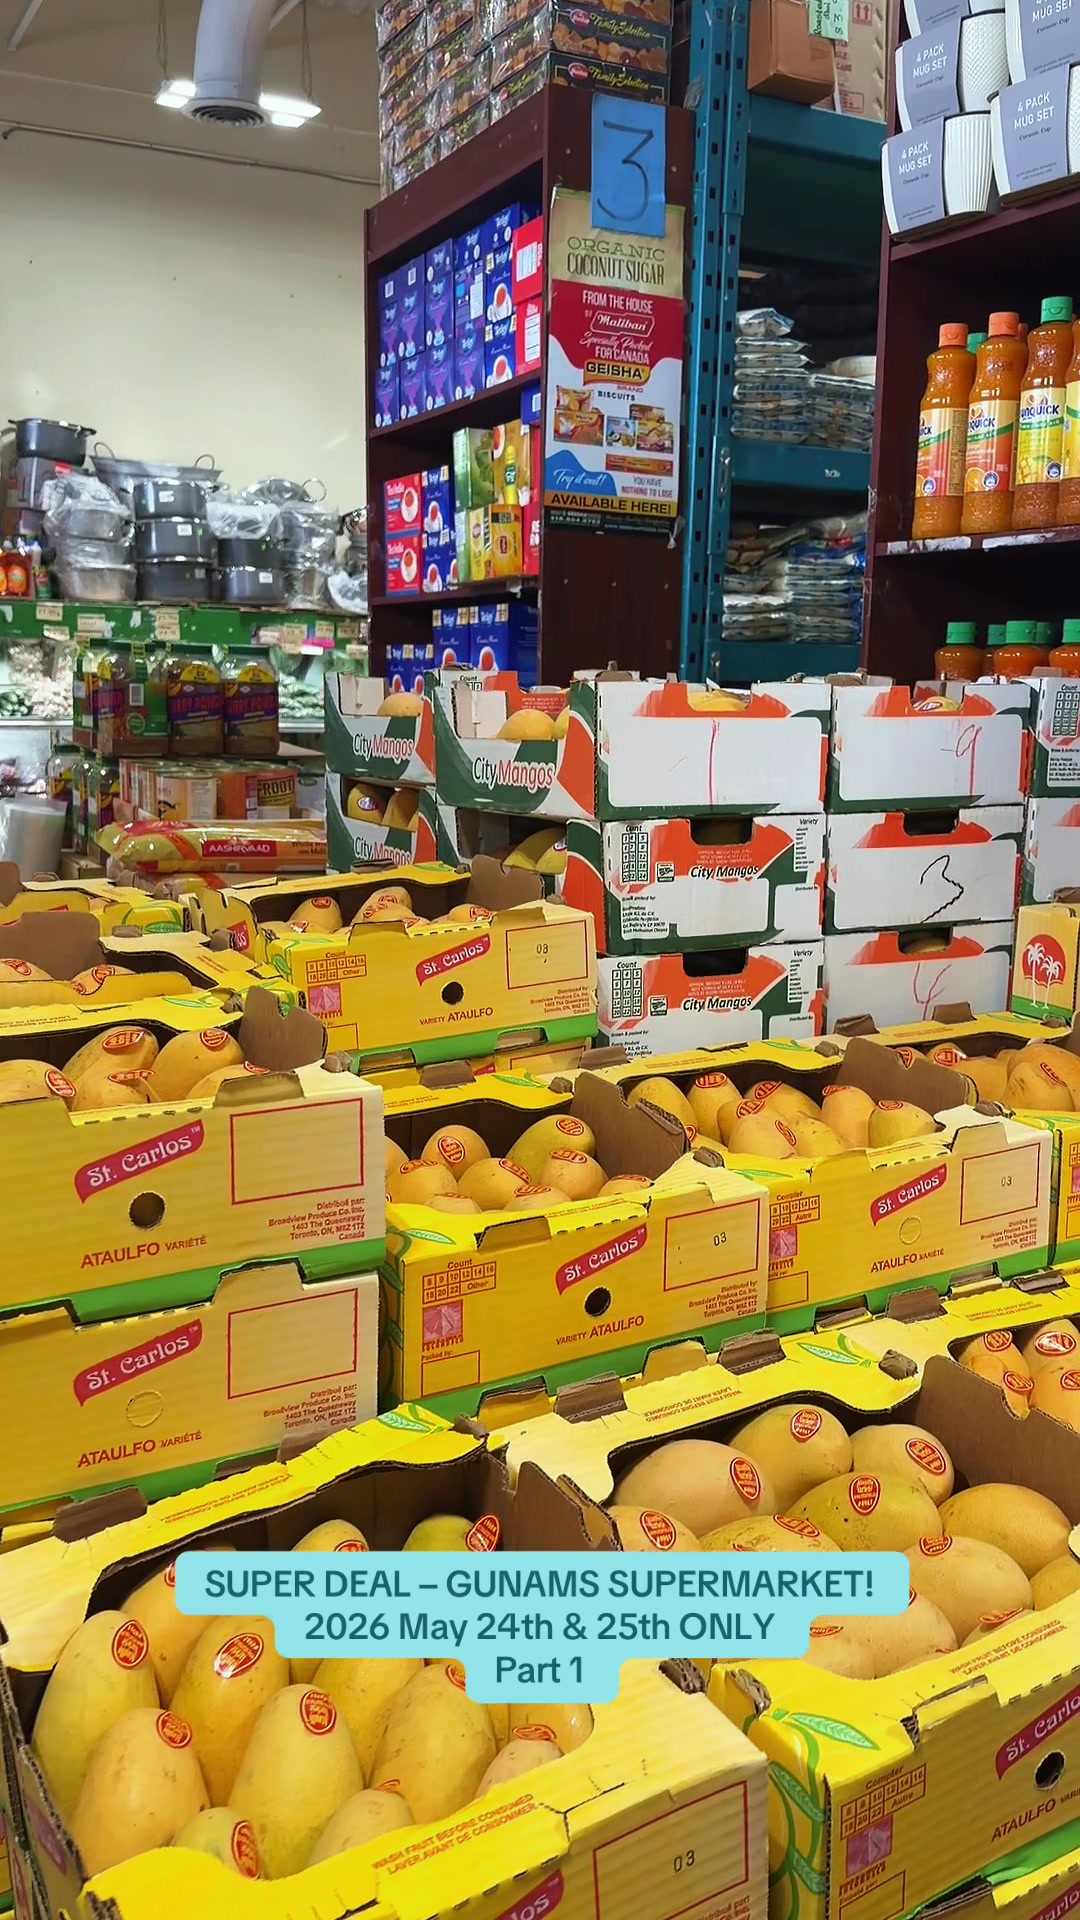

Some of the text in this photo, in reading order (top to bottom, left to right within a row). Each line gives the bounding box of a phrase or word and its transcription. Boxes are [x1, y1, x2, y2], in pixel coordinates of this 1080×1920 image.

[1032, 0, 1072, 22] MUG SET
[916, 43, 944, 62] 4 PACK
[912, 56, 948, 78] MUG SET
[1018, 92, 1050, 112] 4 PACK
[1014, 106, 1055, 130] MUG SET
[902, 142, 929, 160] 4 PACK
[597, 119, 654, 222] 3
[898, 154, 932, 175] MUG SET
[568, 236, 665, 262] ORGANIC
[568, 252, 664, 285] COCONUT SUGAR
[583, 290, 654, 314] FROM THE HOUSE
[598, 314, 646, 331] Maliban
[580, 331, 618, 349] Specially
[595, 346, 650, 364] FOR CANADA
[586, 362, 643, 379] GEISHA
[598, 390, 636, 401] BISCUITS
[554, 468, 607, 489] Try it out!
[634, 476, 662, 488] YOU HAVE
[622, 486, 672, 498] NOTHING TO LOSE
[552, 494, 672, 515] AVAILABLE HERE!
[353, 734, 413, 763] City Mangos
[474, 758, 553, 792] City Mangos
[210, 844, 270, 852] AASHIRVAAD
[354, 837, 410, 864] City Mangos
[691, 866, 758, 880] City Mangos
[423, 944, 484, 974] St. Carlos
[420, 1007, 493, 1024] VARIETY ATAULFO
[684, 998, 752, 1012] City Mangos
[87, 1135, 192, 1187] St. Carlos
[1001, 1176, 1012, 1186] 03
[878, 1174, 940, 1214] St. Carlos
[269, 1215, 306, 1227] Broadview
[308, 1210, 337, 1220] Produce
[338, 1208, 350, 1216] Co.
[292, 1222, 308, 1231] 1403
[310, 1220, 322, 1228] The
[290, 1230, 320, 1240] Toronto,
[321, 1228, 334, 1236] ON,
[352, 1222, 364, 1230] 1T2
[339, 1232, 364, 1240] Canada
[714, 1232, 726, 1247] 03
[80, 1236, 206, 1269] ATAULFO VARIÉTÉ
[564, 1236, 638, 1282] St. Carlos
[870, 1253, 918, 1273] ATAULFO
[448, 1258, 472, 1270] Count
[450, 1273, 458, 1281] 10
[462, 1270, 470, 1278] 12
[474, 1268, 482, 1276] 14
[438, 1288, 446, 1296] 20
[450, 1286, 458, 1294] 22
[467, 1280, 488, 1290] Other
[556, 1315, 644, 1346] VARIETY ATAULFO
[86, 1336, 189, 1390] St. Carlos
[78, 1430, 202, 1468] ATAULFO VARIÉTÉ
[1006, 1738, 1030, 1762] St.
[866, 1766, 904, 1790] Compter
[992, 1798, 1056, 1843] ATAULFO
[372, 1794, 534, 1870] WASH FRUIT BEFORE CONSUMED
[388, 1854, 421, 1875] LAVER
[423, 1840, 455, 1860] AVANT
[456, 1832, 472, 1844] DE
[673, 1850, 695, 1874] 03
